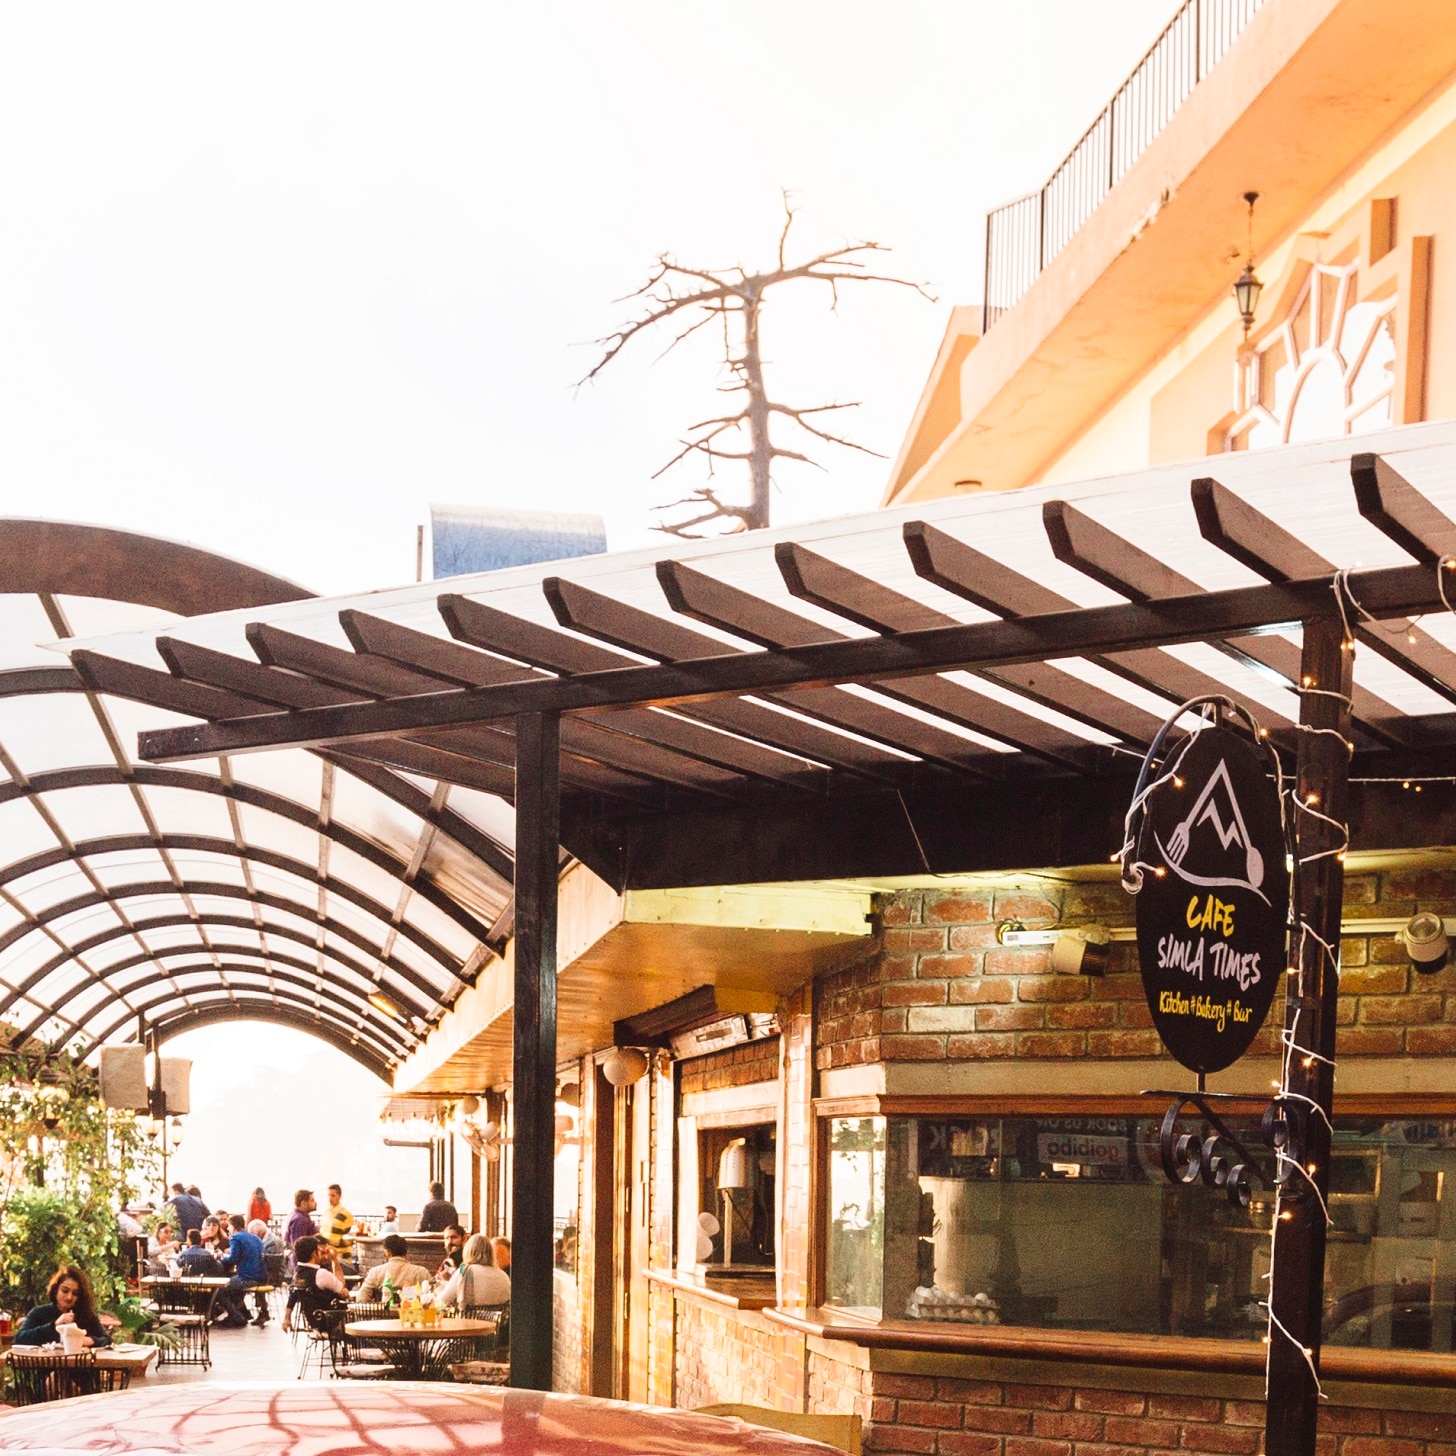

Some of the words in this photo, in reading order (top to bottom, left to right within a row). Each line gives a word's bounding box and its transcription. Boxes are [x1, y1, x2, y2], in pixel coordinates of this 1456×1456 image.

[1186, 894, 1236, 937] CAFE
[1157, 933, 1204, 981] SIMLA
[1209, 941, 1262, 991] TIMES
